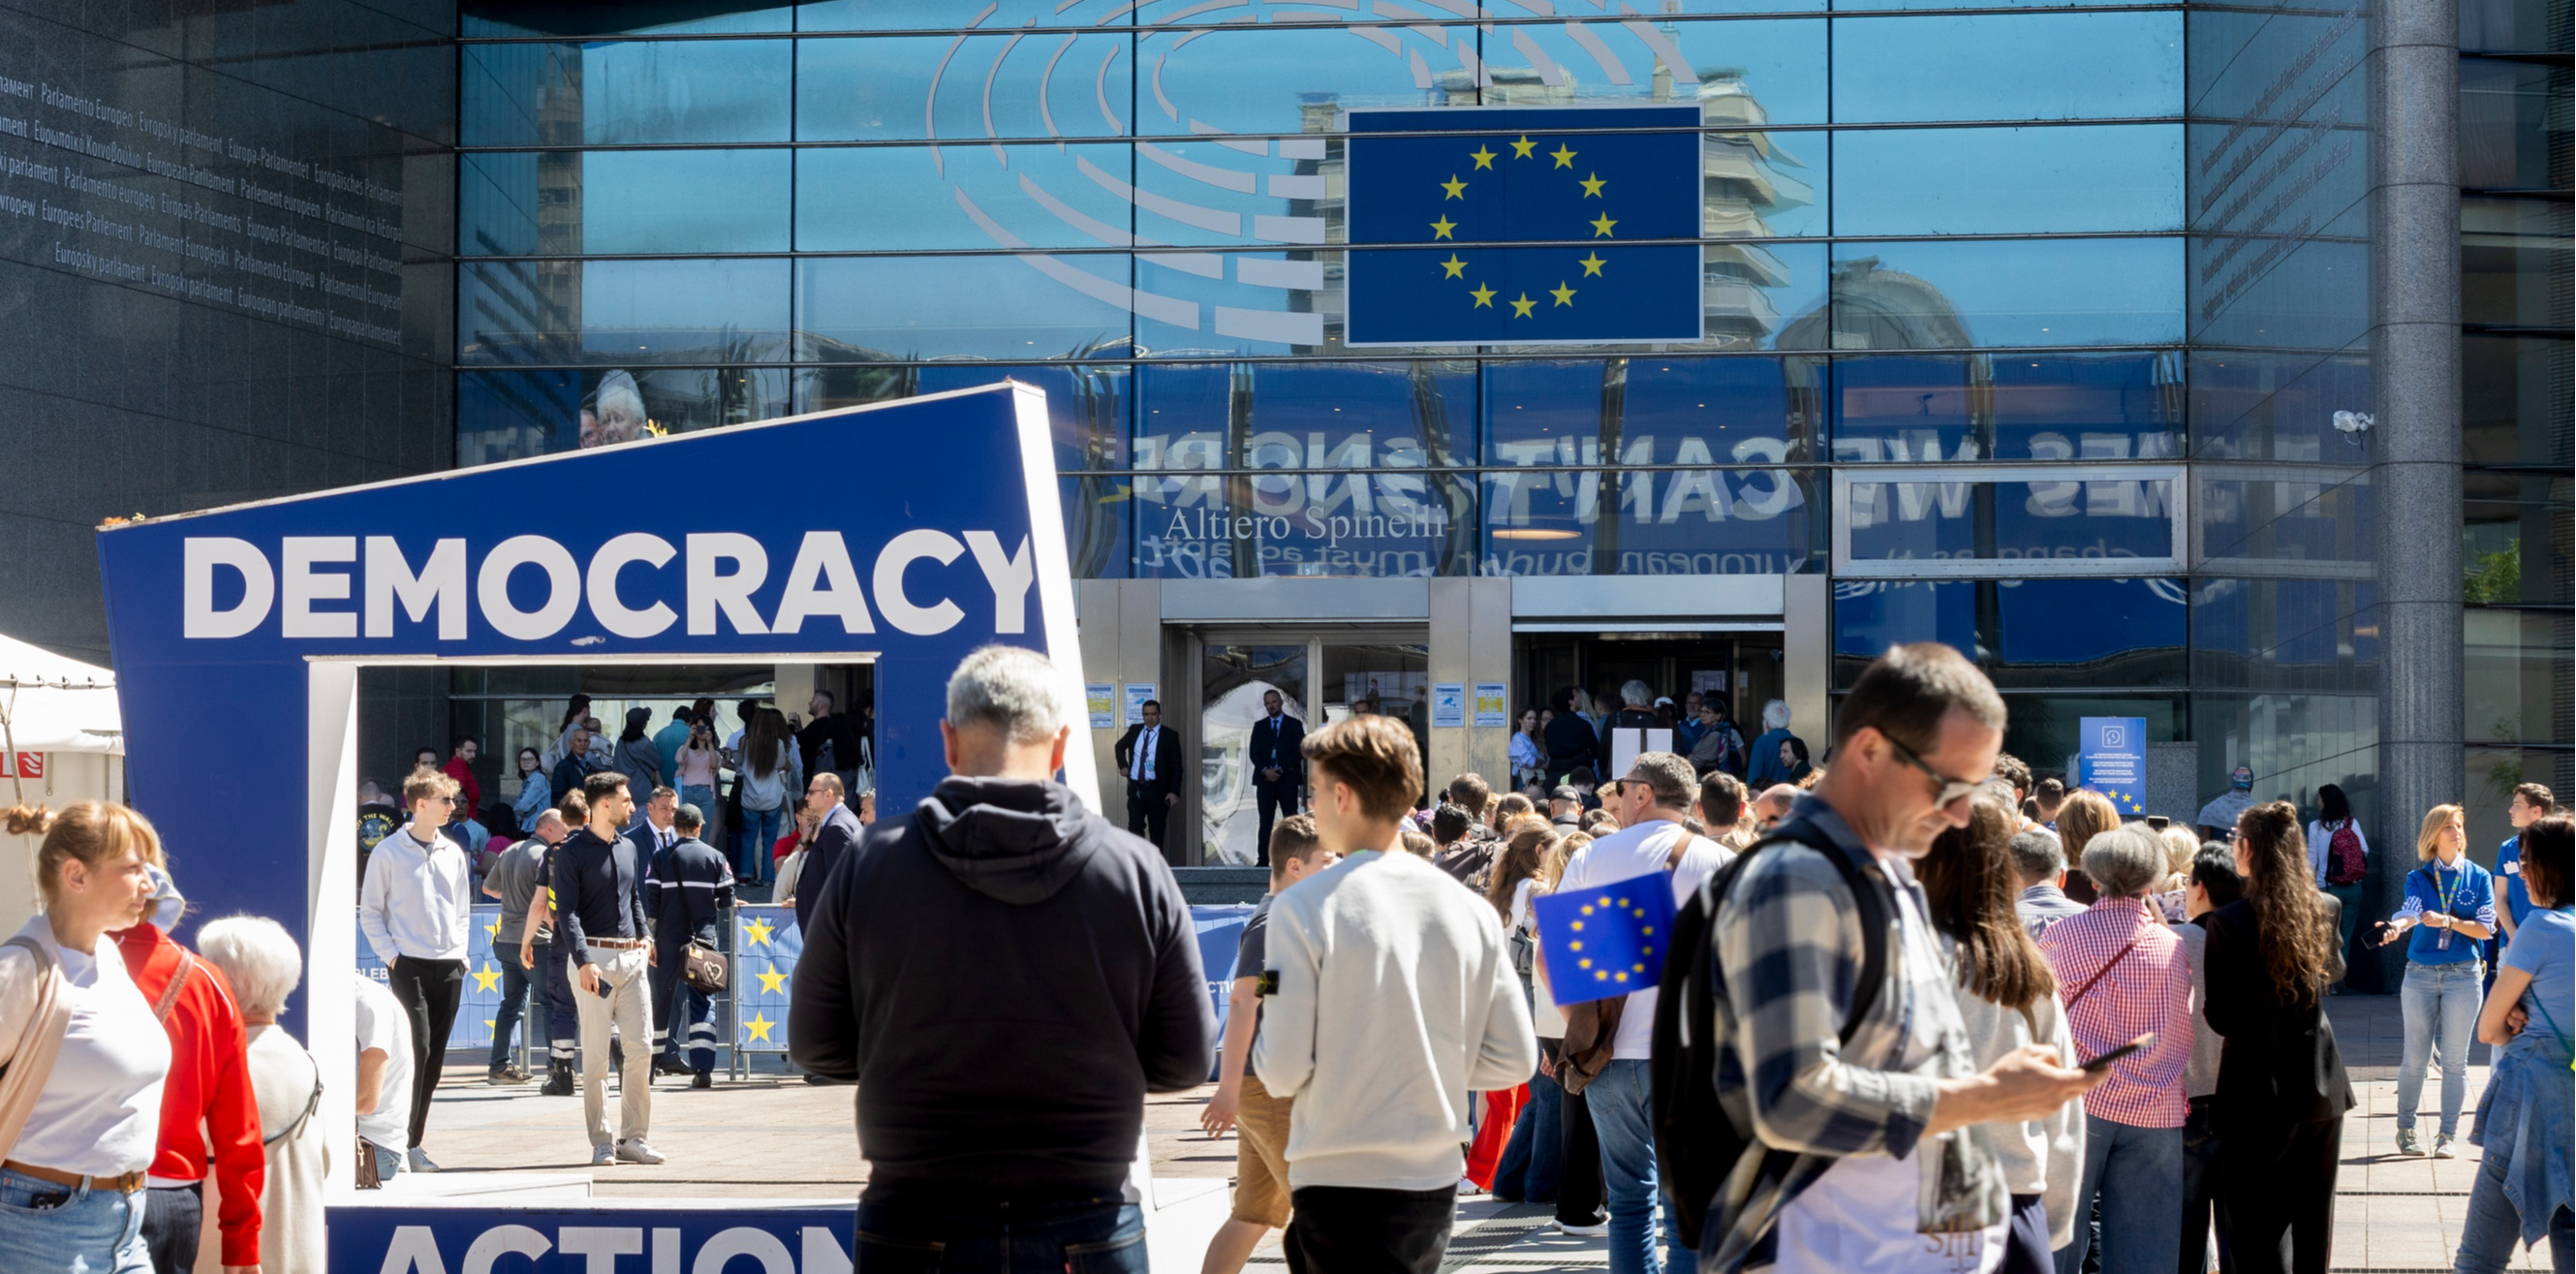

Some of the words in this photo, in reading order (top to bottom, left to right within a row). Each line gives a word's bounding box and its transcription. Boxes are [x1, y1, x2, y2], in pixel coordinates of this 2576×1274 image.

[42, 81, 94, 116] Parlamento
[96, 98, 134, 129] Europeo
[179, 126, 223, 154] parlament
[228, 138, 309, 180] Europa-Parlamentet
[315, 162, 363, 196] Europäisches
[364, 177, 403, 206] Parlament
[86, 135, 141, 169] Κοινοβούλιο
[147, 151, 187, 181] European
[190, 164, 234, 195] Parliament
[240, 177, 283, 209] Parlement
[284, 196, 321, 220] européen
[326, 202, 365, 233] Parlaimint
[365, 219, 376, 234] na
[377, 217, 403, 244] hEorpa
[9, 155, 58, 184] parlament
[64, 166, 117, 201] Parlamento
[118, 186, 155, 212] europeo
[161, 192, 192, 222] Eiropas
[194, 202, 241, 233] Parlaments
[247, 216, 279, 245] Europos
[281, 225, 329, 257] Parlamentas
[334, 239, 362, 268] Európai
[364, 247, 402, 277] Parlament
[42, 199, 84, 230] Europees
[86, 210, 133, 242] Parlement
[139, 224, 184, 255] Parlament
[185, 236, 229, 268] Europejski
[234, 249, 282, 279] Parlamento
[283, 261, 315, 291] Europeu
[320, 271, 367, 301] Parlamentul
[368, 284, 402, 311] European
[55, 240, 98, 275] Európsky
[99, 255, 145, 281] parlament
[151, 264, 188, 295] Evropski
[189, 276, 233, 304] parlament
[238, 286, 276, 317] Euroopan
[277, 298, 325, 326] parlamentti
[329, 309, 402, 346] Europaparlamentet
[1164, 506, 1291, 541] Altiero
[1305, 505, 1445, 548] Spinelli
[183, 529, 1034, 640] DEMOCRACY
[379, 813, 395, 828] WALL
